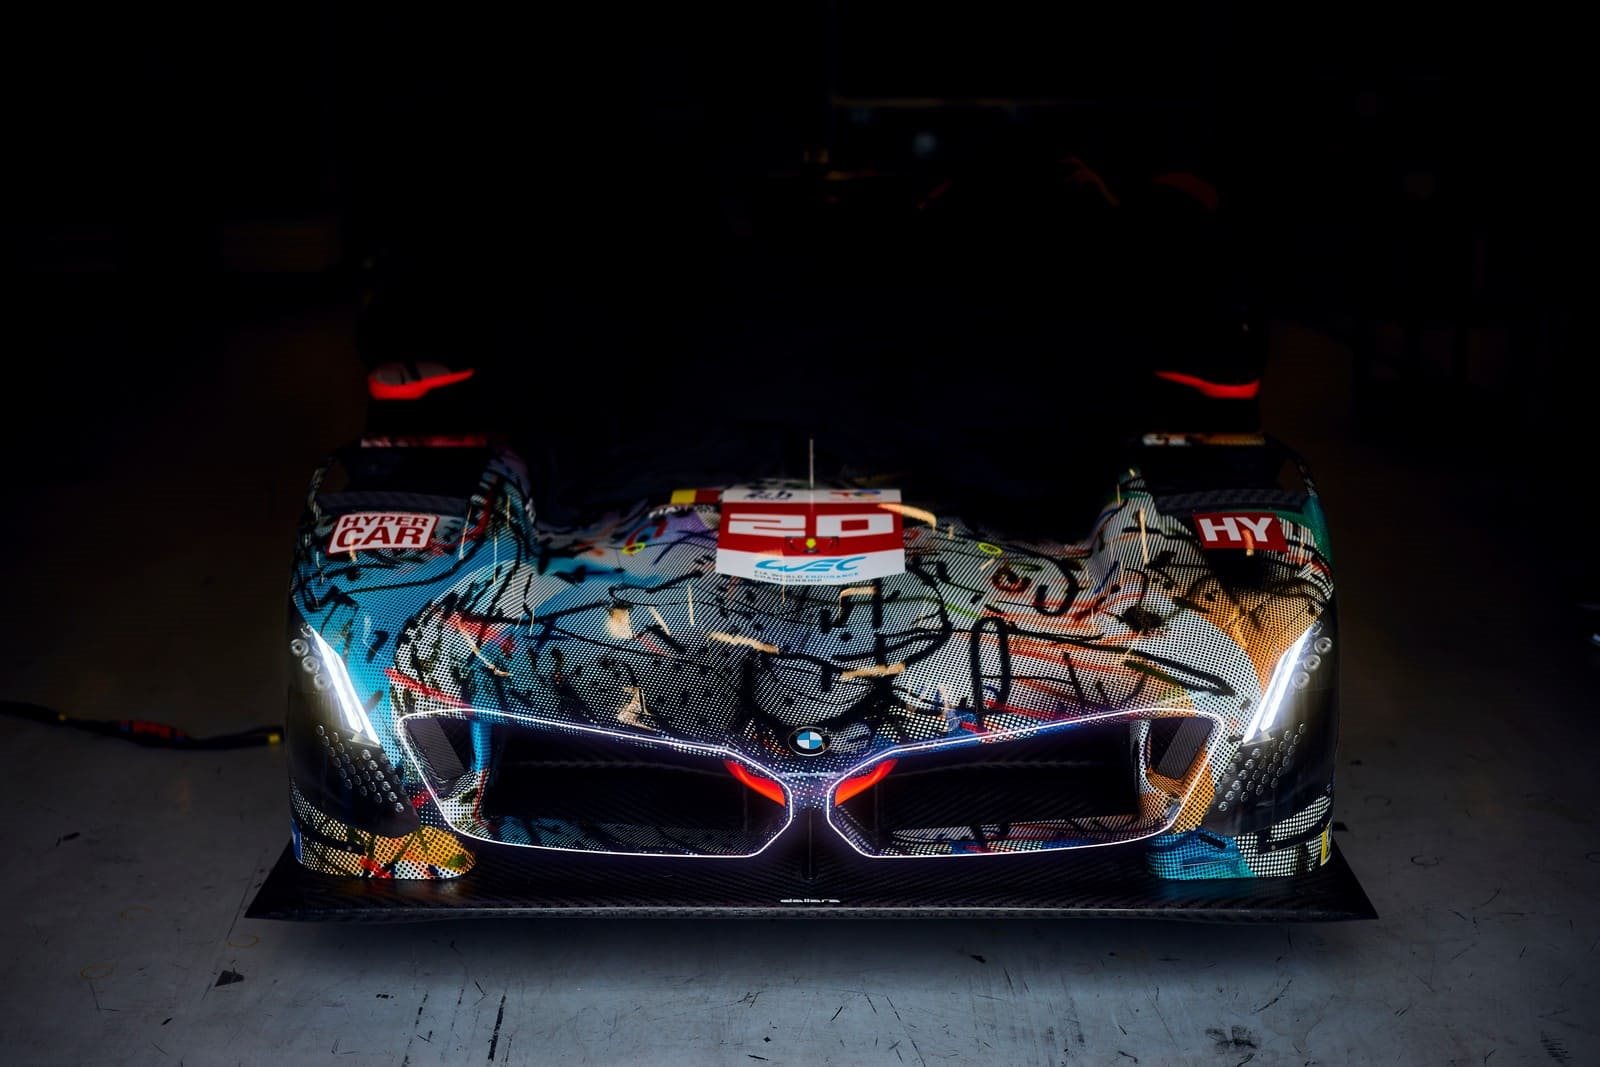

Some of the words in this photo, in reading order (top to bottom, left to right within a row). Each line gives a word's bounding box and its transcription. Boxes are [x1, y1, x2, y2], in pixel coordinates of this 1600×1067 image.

[342, 516, 428, 527] HYPER
[728, 513, 894, 537] 20
[1199, 517, 1273, 542] HY
[336, 527, 424, 547] CAR
[755, 556, 866, 572] WEC
